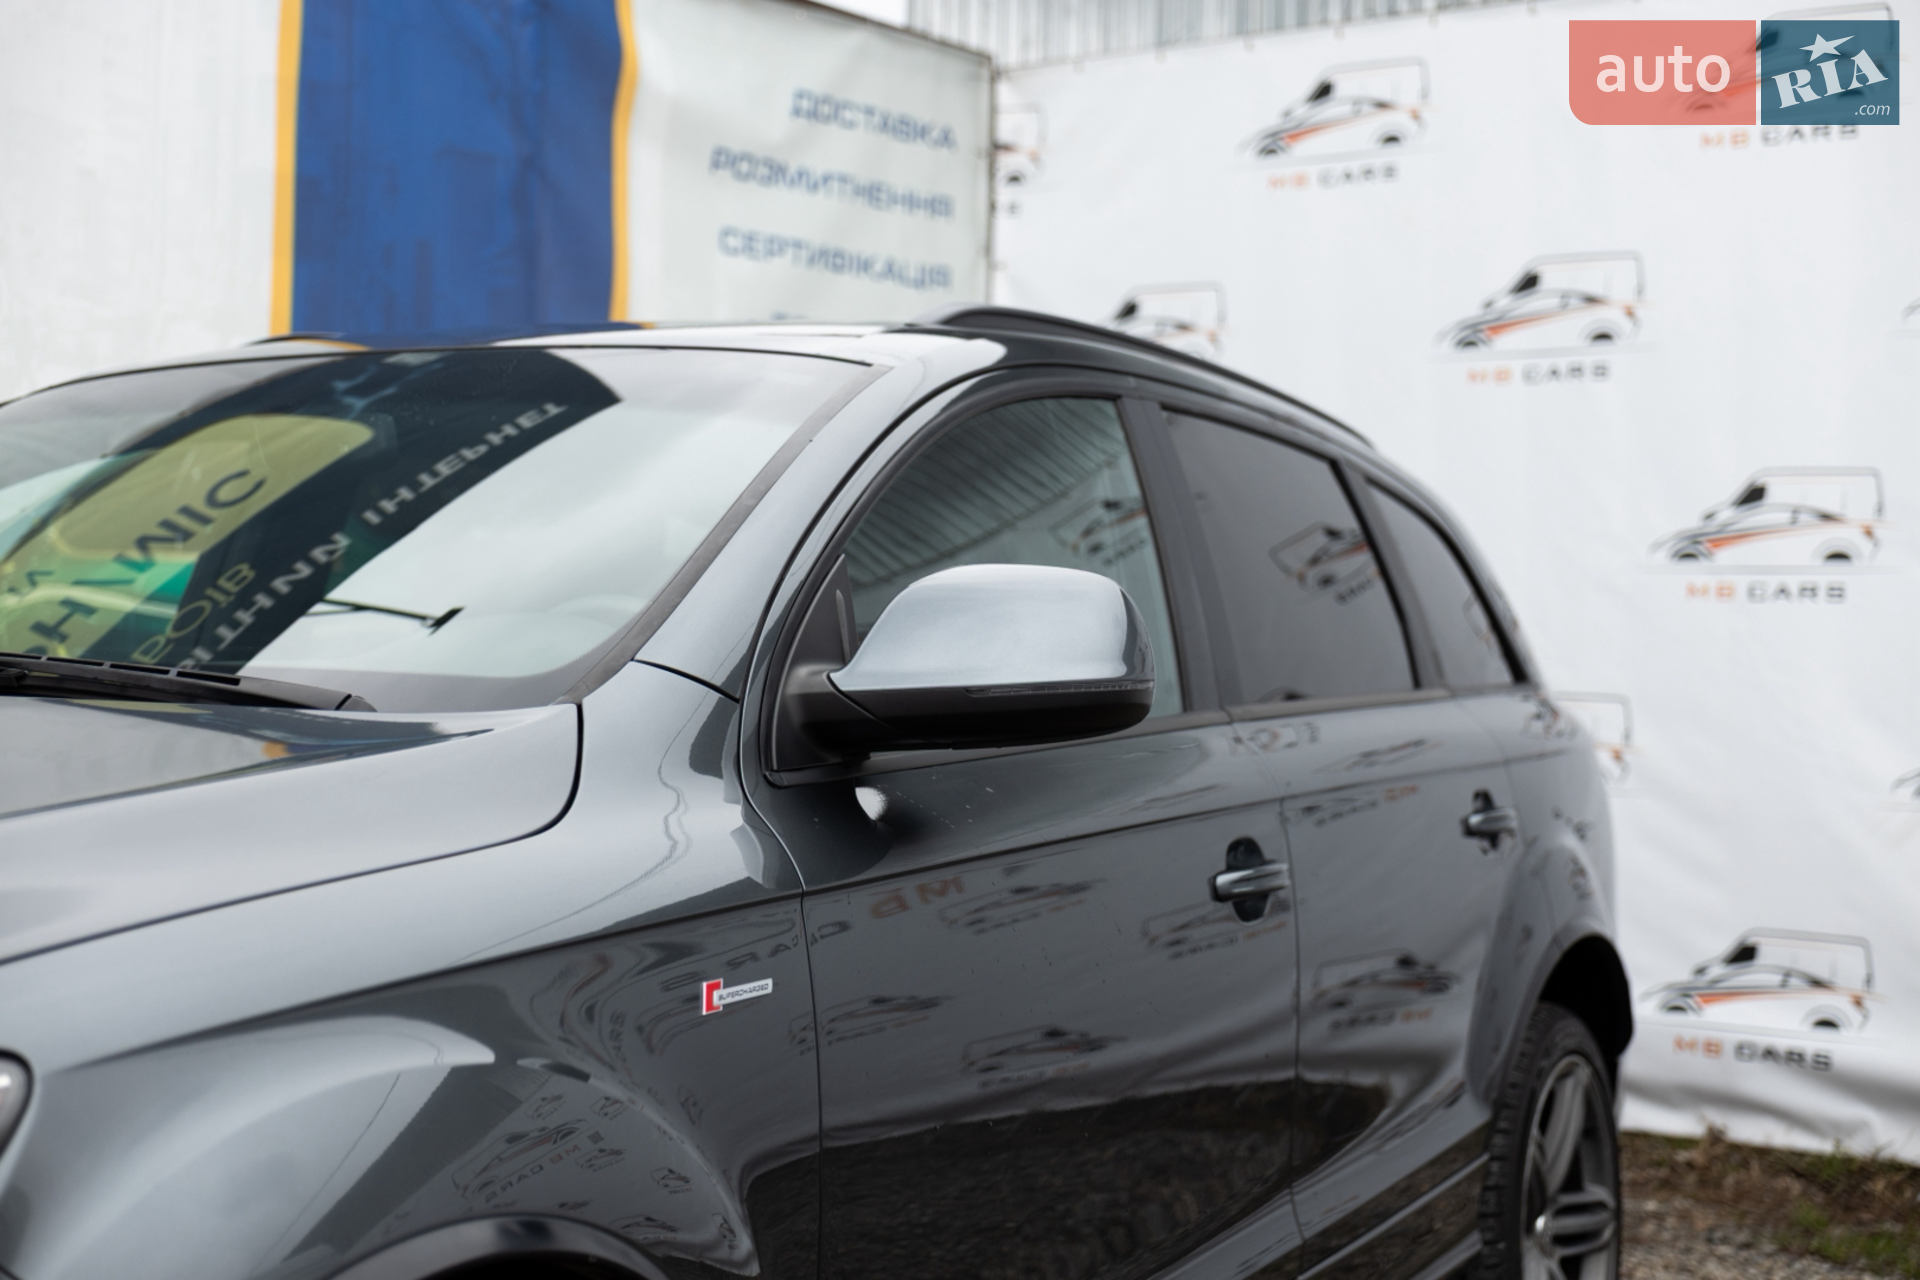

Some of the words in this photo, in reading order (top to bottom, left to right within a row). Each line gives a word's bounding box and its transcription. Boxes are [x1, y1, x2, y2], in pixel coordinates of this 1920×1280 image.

[789, 88, 958, 151] ДОСТАВКА
[709, 145, 955, 220] РОЗМИТНЕННЯ
[1316, 161, 1398, 189] CARS
[717, 225, 954, 291] СЕРТИФІКАЦІЯ
[1521, 359, 1611, 386] CARS
[1746, 580, 1847, 604] CARS
[1733, 1039, 1834, 1073] CARS
